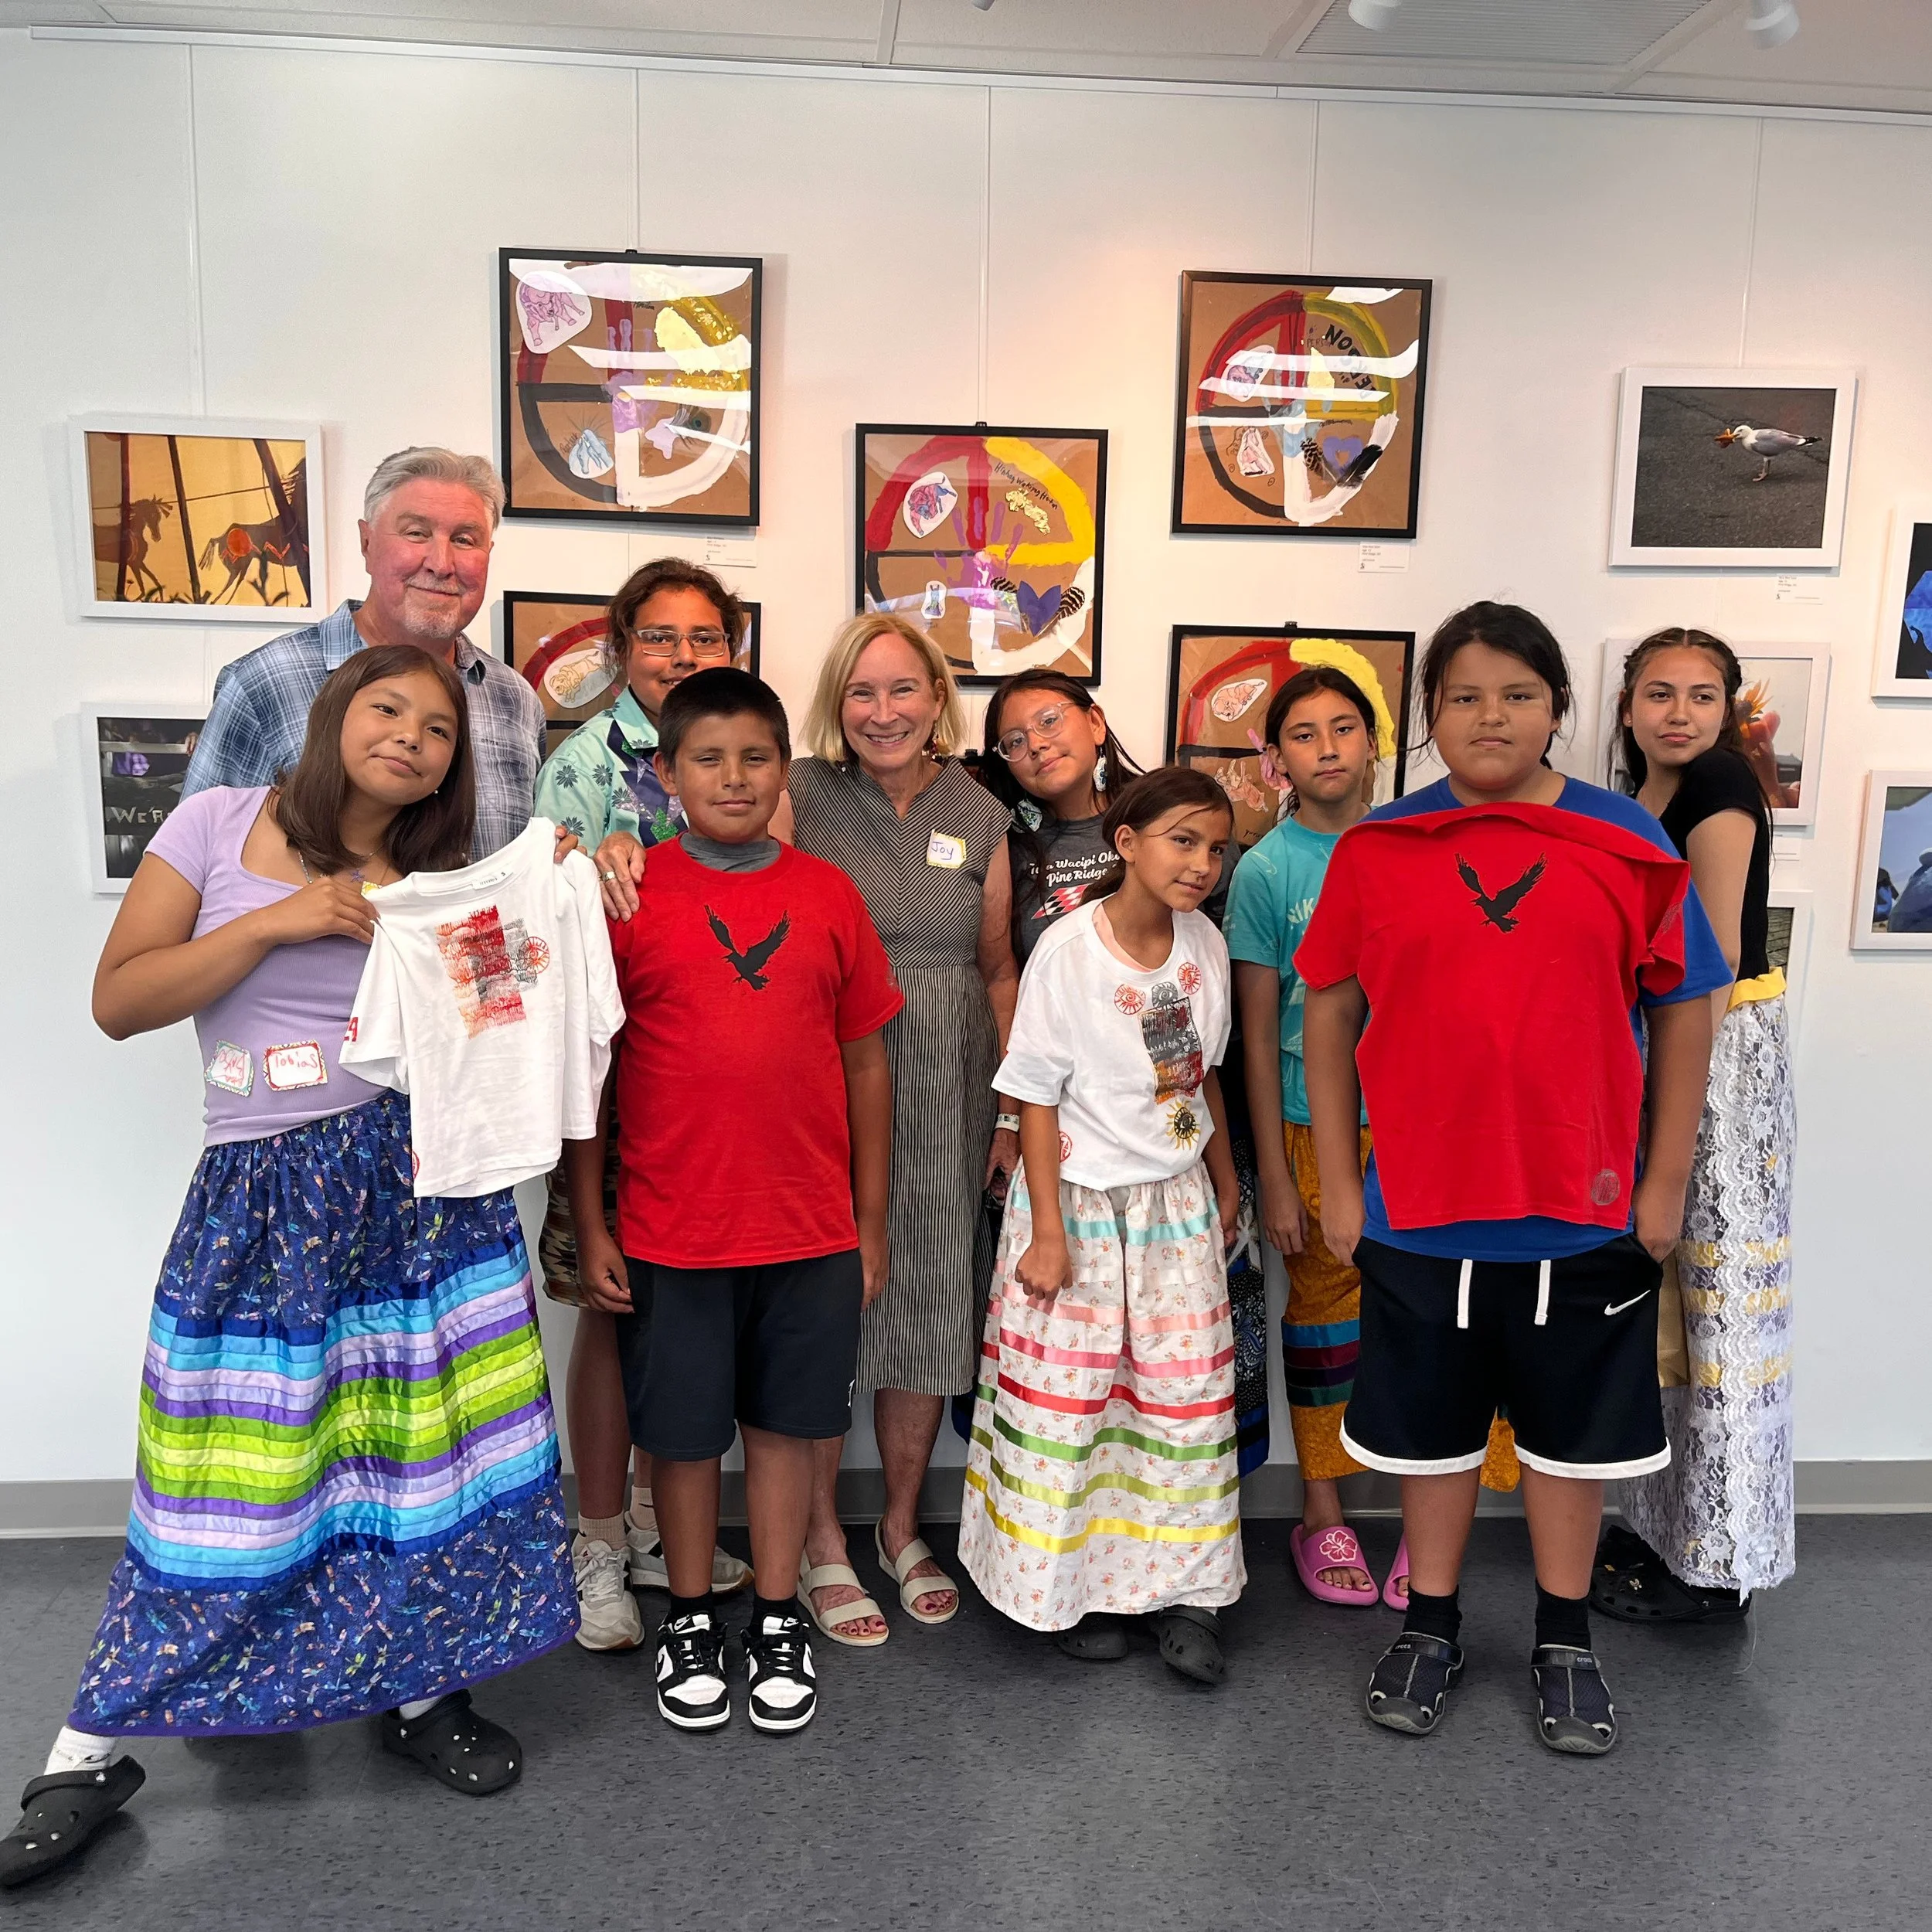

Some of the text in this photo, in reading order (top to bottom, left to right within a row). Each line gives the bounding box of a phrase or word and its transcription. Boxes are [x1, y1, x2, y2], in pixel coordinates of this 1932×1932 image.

[930, 841, 954, 861] Joy
[1056, 854, 1096, 869] Wacipi
[1046, 868, 1108, 887] Pine Ridge
